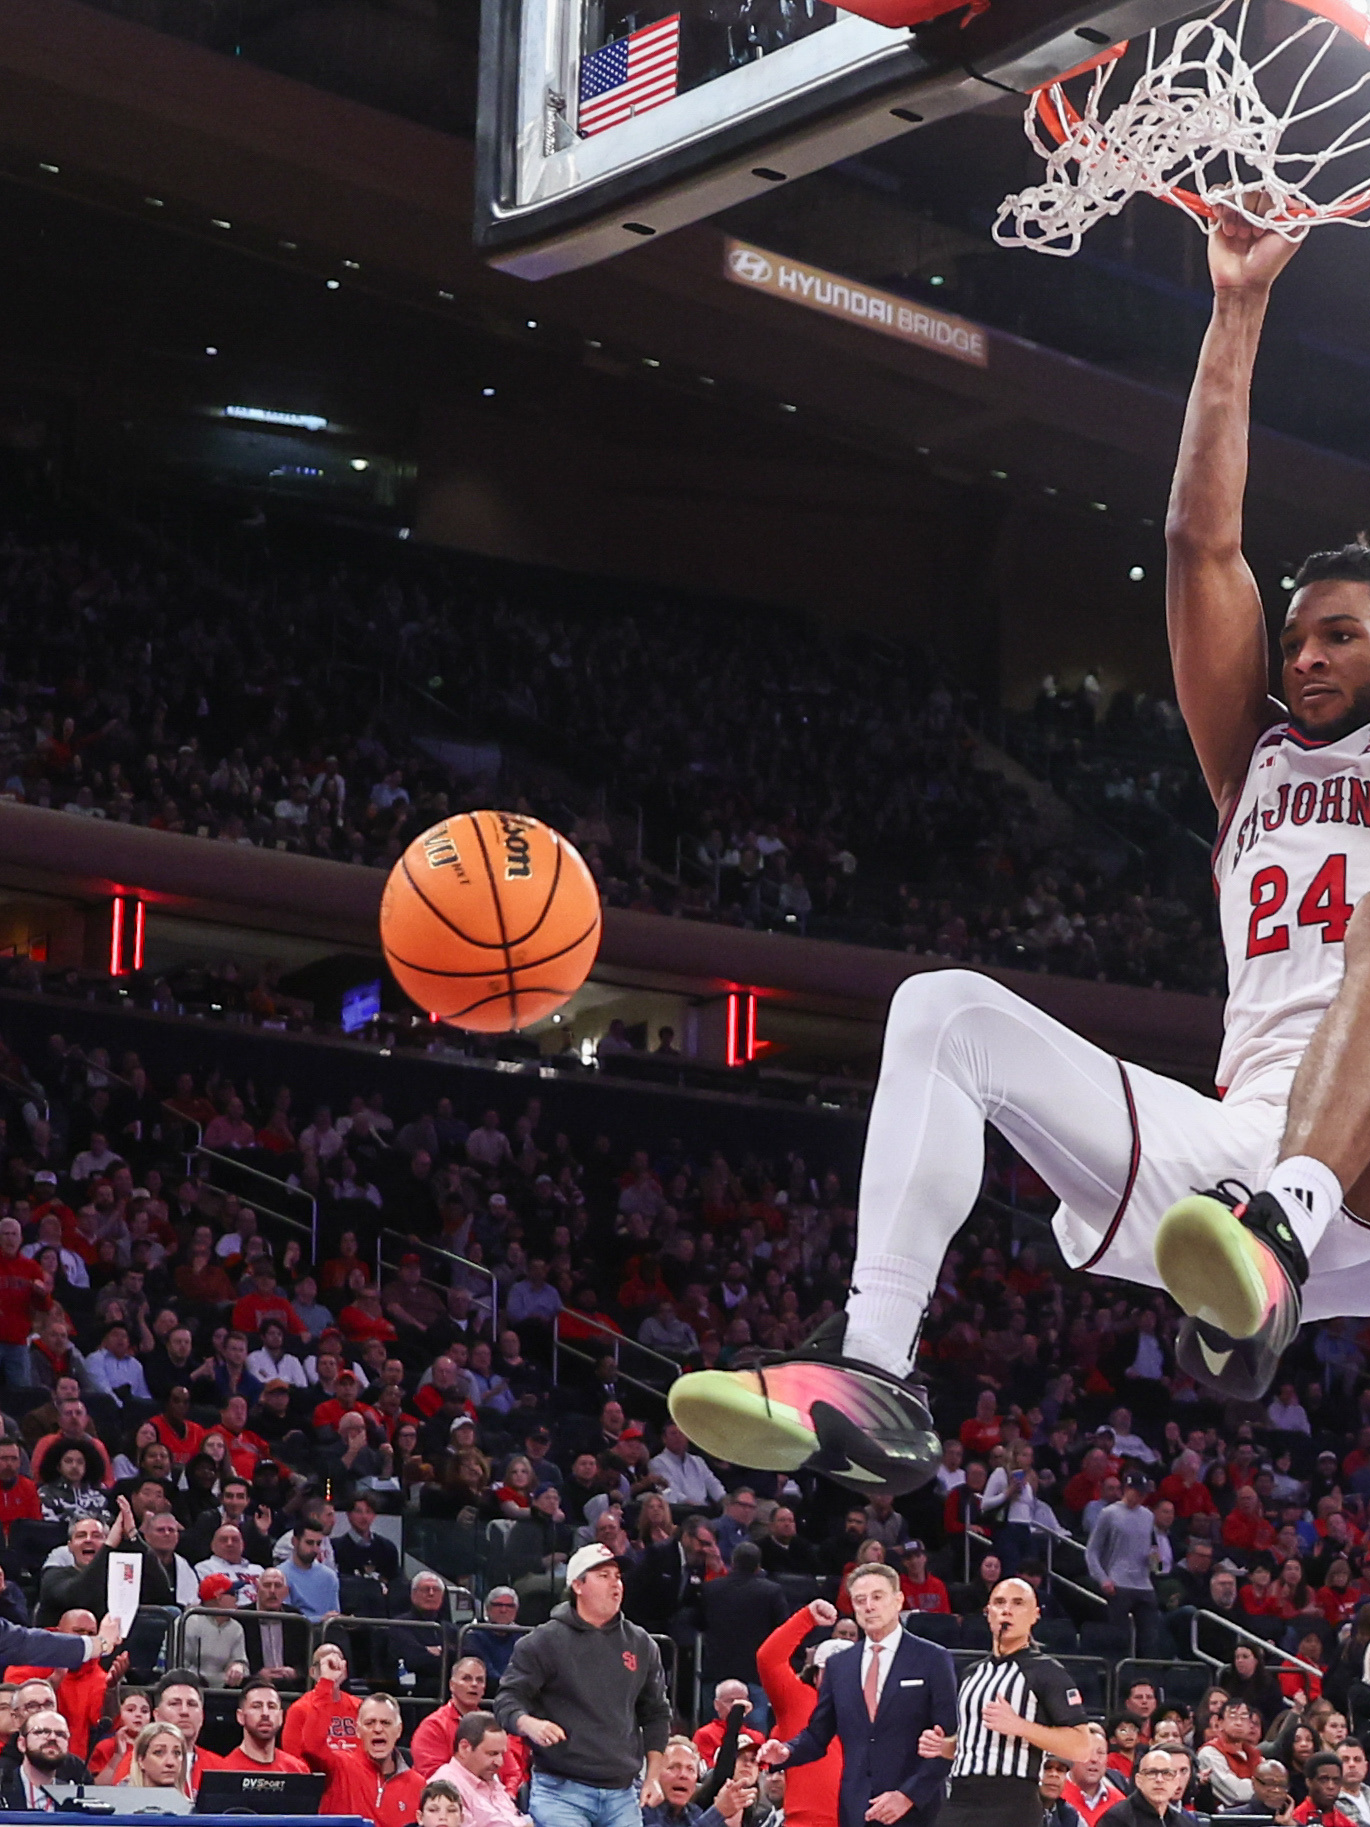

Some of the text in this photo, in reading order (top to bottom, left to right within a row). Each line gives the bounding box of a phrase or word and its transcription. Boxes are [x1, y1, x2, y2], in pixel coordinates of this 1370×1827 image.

[778, 265, 984, 358] HYUNDAI BRIDGE
[1246, 853, 1355, 960] 24
